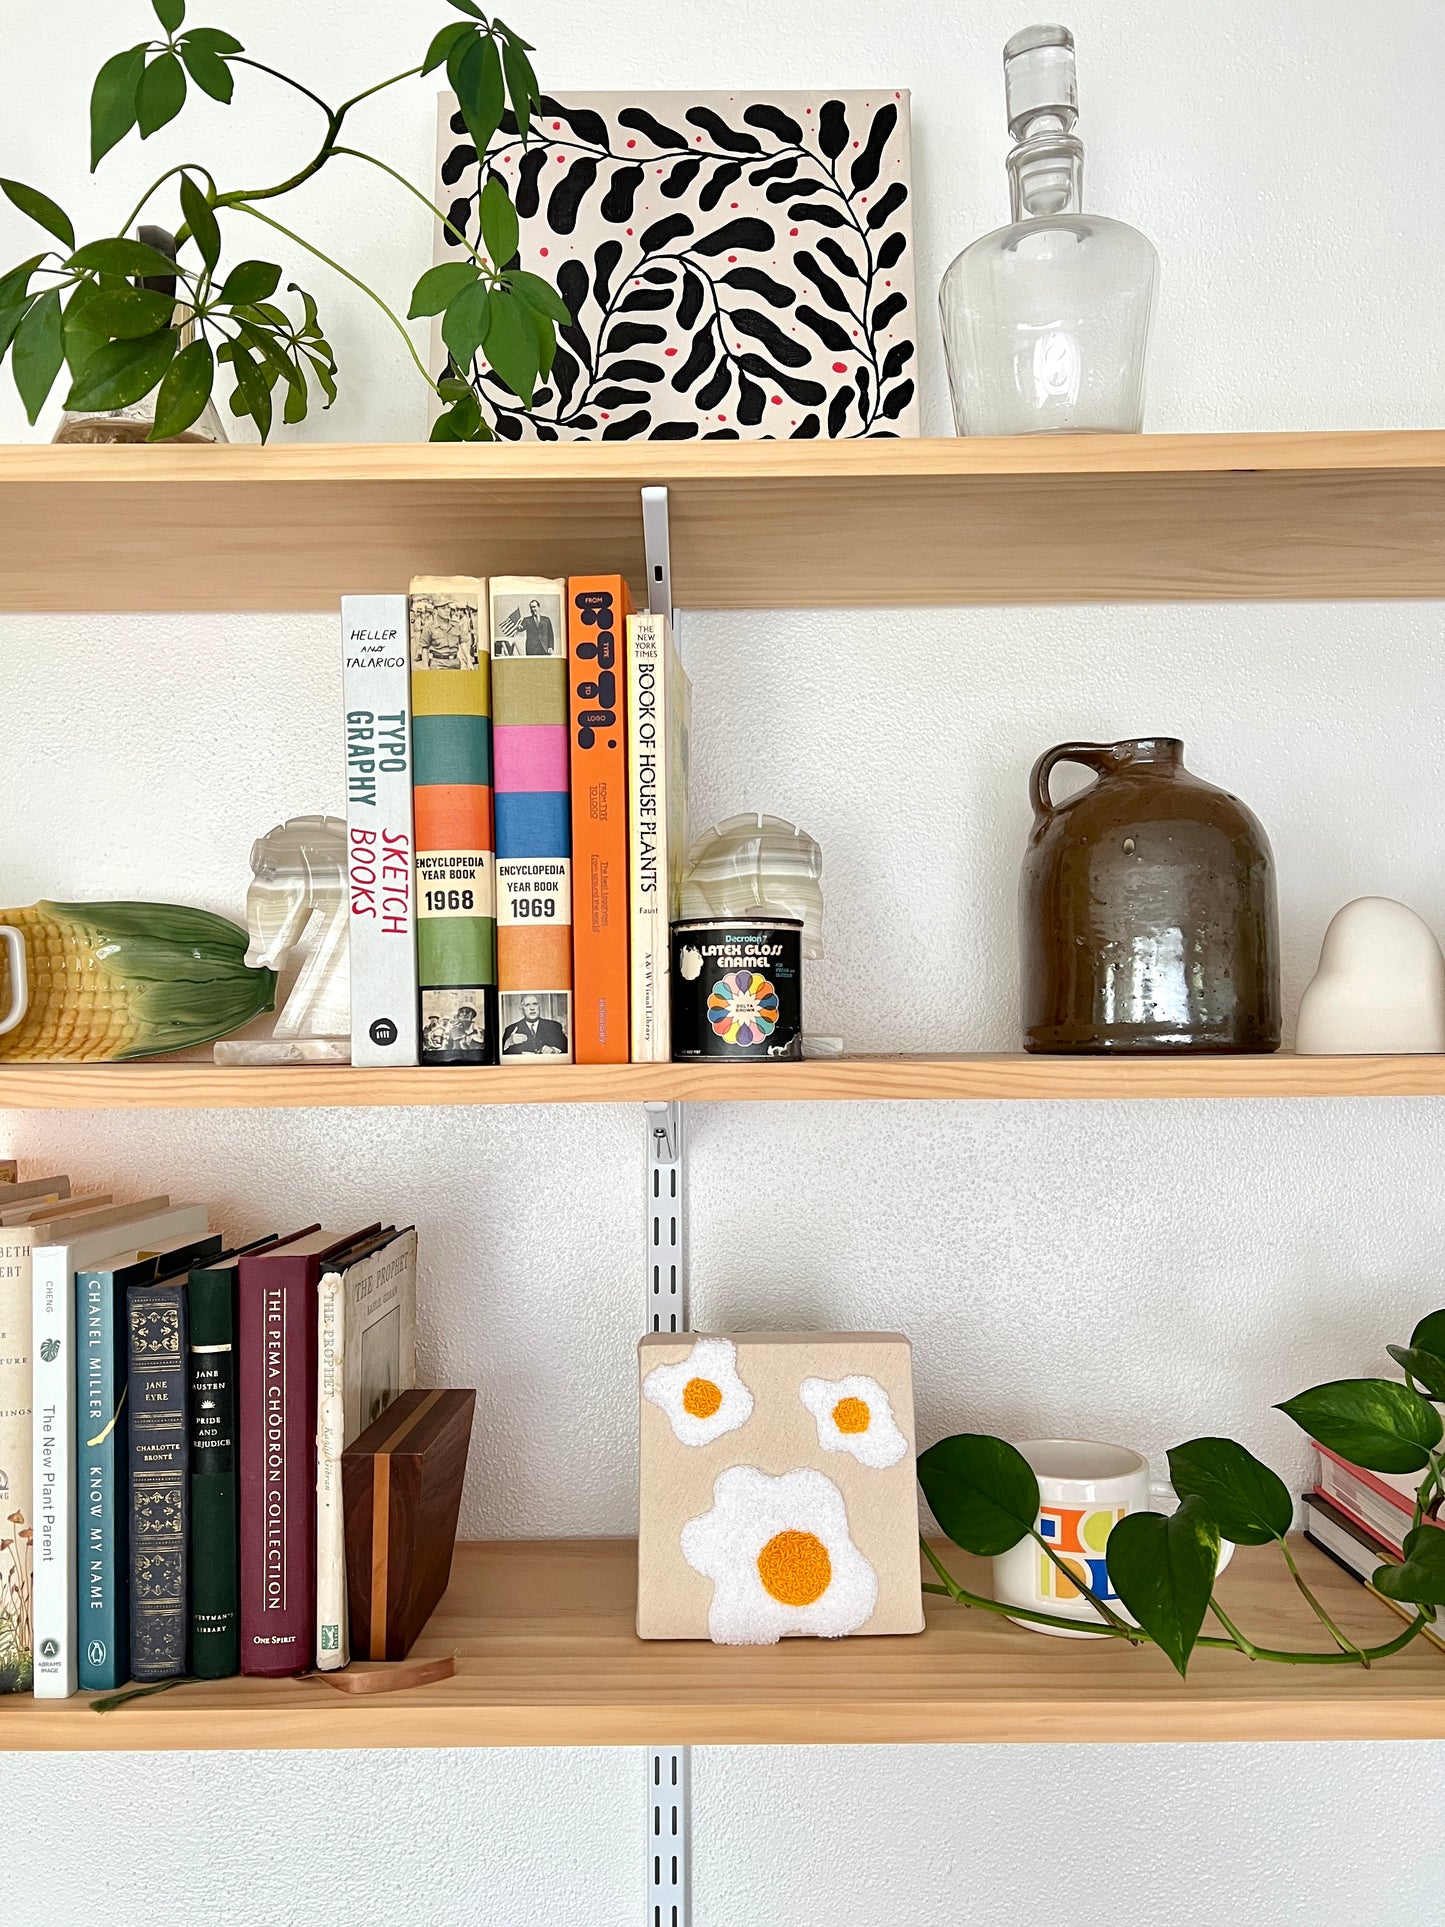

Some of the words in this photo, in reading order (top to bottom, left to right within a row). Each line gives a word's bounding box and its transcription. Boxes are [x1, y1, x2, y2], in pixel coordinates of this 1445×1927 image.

[350, 629, 397, 641] HELLER
[360, 645, 386, 653] AND
[635, 650, 658, 658] TIMES
[346, 657, 405, 669] TALARICO
[638, 664, 655, 719] BOOK
[378, 710, 407, 772] TYPO
[639, 723, 656, 748] OF
[346, 711, 377, 807] GRAPHY
[591, 786, 598, 796] TO
[600, 782, 608, 803] FROM
[639, 754, 657, 817] HOUSE
[591, 798, 599, 819] LOGO
[600, 805, 608, 822] TYPE
[416, 857, 484, 869] ENCYCLOPEDIA
[640, 821, 657, 892] PLANTS
[350, 828, 377, 918] BOOKS
[381, 828, 409, 934] SKETCH
[422, 870, 446, 880] YEAR
[449, 869, 476, 880] BOOK
[499, 865, 565, 876] ENCYCLOPEDIA
[507, 882, 531, 893] YEAR
[534, 881, 559, 892] BOOK
[425, 890, 474, 911] 1968
[510, 898, 556, 918] 1969
[639, 907, 658, 915] Faust
[702, 944, 742, 956] LATEX
[744, 944, 783, 956] GLOSS
[717, 957, 770, 968] ENAMEL
[644, 1010, 653, 1041] Library
[355, 1275, 373, 1303] THE
[376, 1251, 409, 1289] PROPHET
[45, 1280, 53, 1313] CHENG
[268, 1289, 281, 1322] THE
[323, 1292, 335, 1324] THE
[88, 1280, 101, 1347] CHANEL
[268, 1331, 281, 1378] PEMA
[323, 1329, 335, 1398] PROPHET
[145, 1381, 168, 1391] JANE
[196, 1370, 219, 1379] JANE
[89, 1358, 102, 1418] MILLER
[145, 1393, 169, 1401] EYRE
[42, 1405, 55, 1432] The
[196, 1416, 221, 1425] PRIDE
[198, 1428, 218, 1436] AND
[268, 1386, 284, 1482] CHÖDRÖN
[42, 1437, 55, 1468] New
[136, 1443, 180, 1452] CHARLOTTE
[144, 1452, 173, 1461] BRONTÉ
[42, 1473, 55, 1510] Plant
[90, 1467, 102, 1518] KNOW
[42, 1514, 55, 1562] Parent
[90, 1528, 102, 1552] MY
[268, 1490, 281, 1609] COLLECTION
[90, 1561, 103, 1609] NAME
